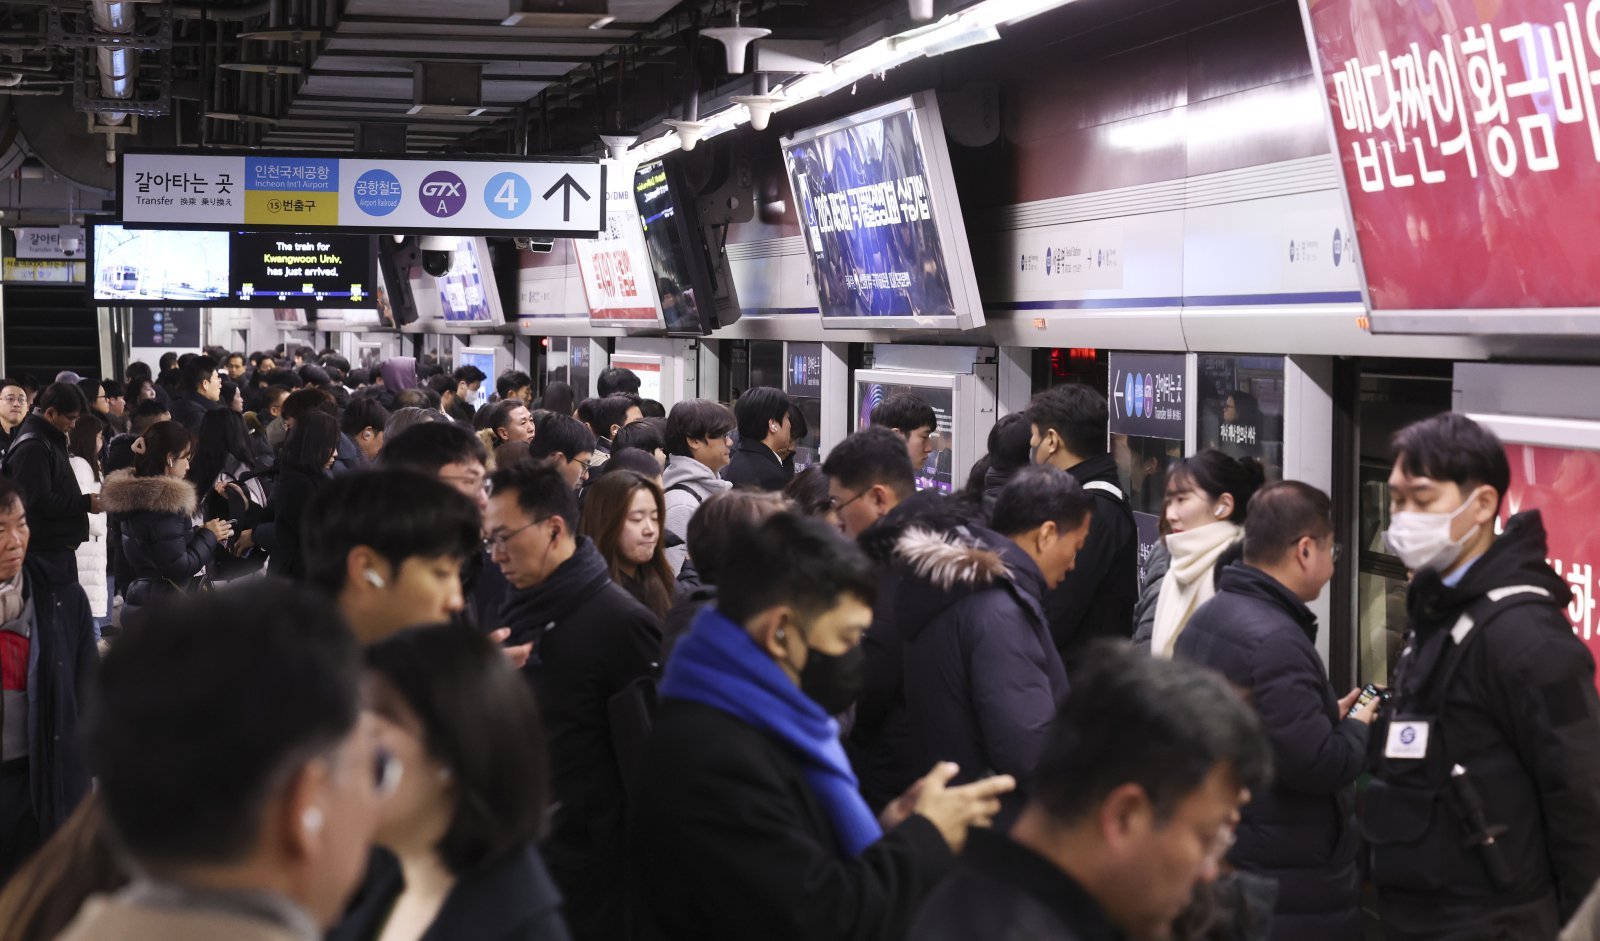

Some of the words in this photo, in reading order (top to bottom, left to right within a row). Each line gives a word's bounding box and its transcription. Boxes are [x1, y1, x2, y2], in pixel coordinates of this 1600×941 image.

[255, 165, 330, 180] 인천국제공항
[135, 172, 208, 194] 갈아타는
[215, 174, 234, 194] 곳
[255, 179, 286, 188] Incheon
[287, 180, 301, 188] Int'l
[302, 181, 329, 189] Airport
[356, 180, 400, 196] 공항철도
[422, 181, 462, 197] GTX
[136, 196, 174, 206] Transfer
[494, 179, 518, 211] 4
[360, 198, 377, 206] Airport
[378, 199, 398, 207] Railroad
[437, 202, 447, 214] A
[29, 233, 61, 246] 갈아타
[276, 241, 293, 251] The
[294, 242, 315, 251] train
[316, 242, 330, 251] for
[263, 253, 318, 265] Kwangwoon
[319, 254, 342, 264] Univ.
[266, 266, 283, 276] has
[284, 266, 302, 277] just
[304, 267, 339, 277] arrived.
[1155, 374, 1176, 403] 갈아타는
[1176, 374, 1182, 403] 곳
